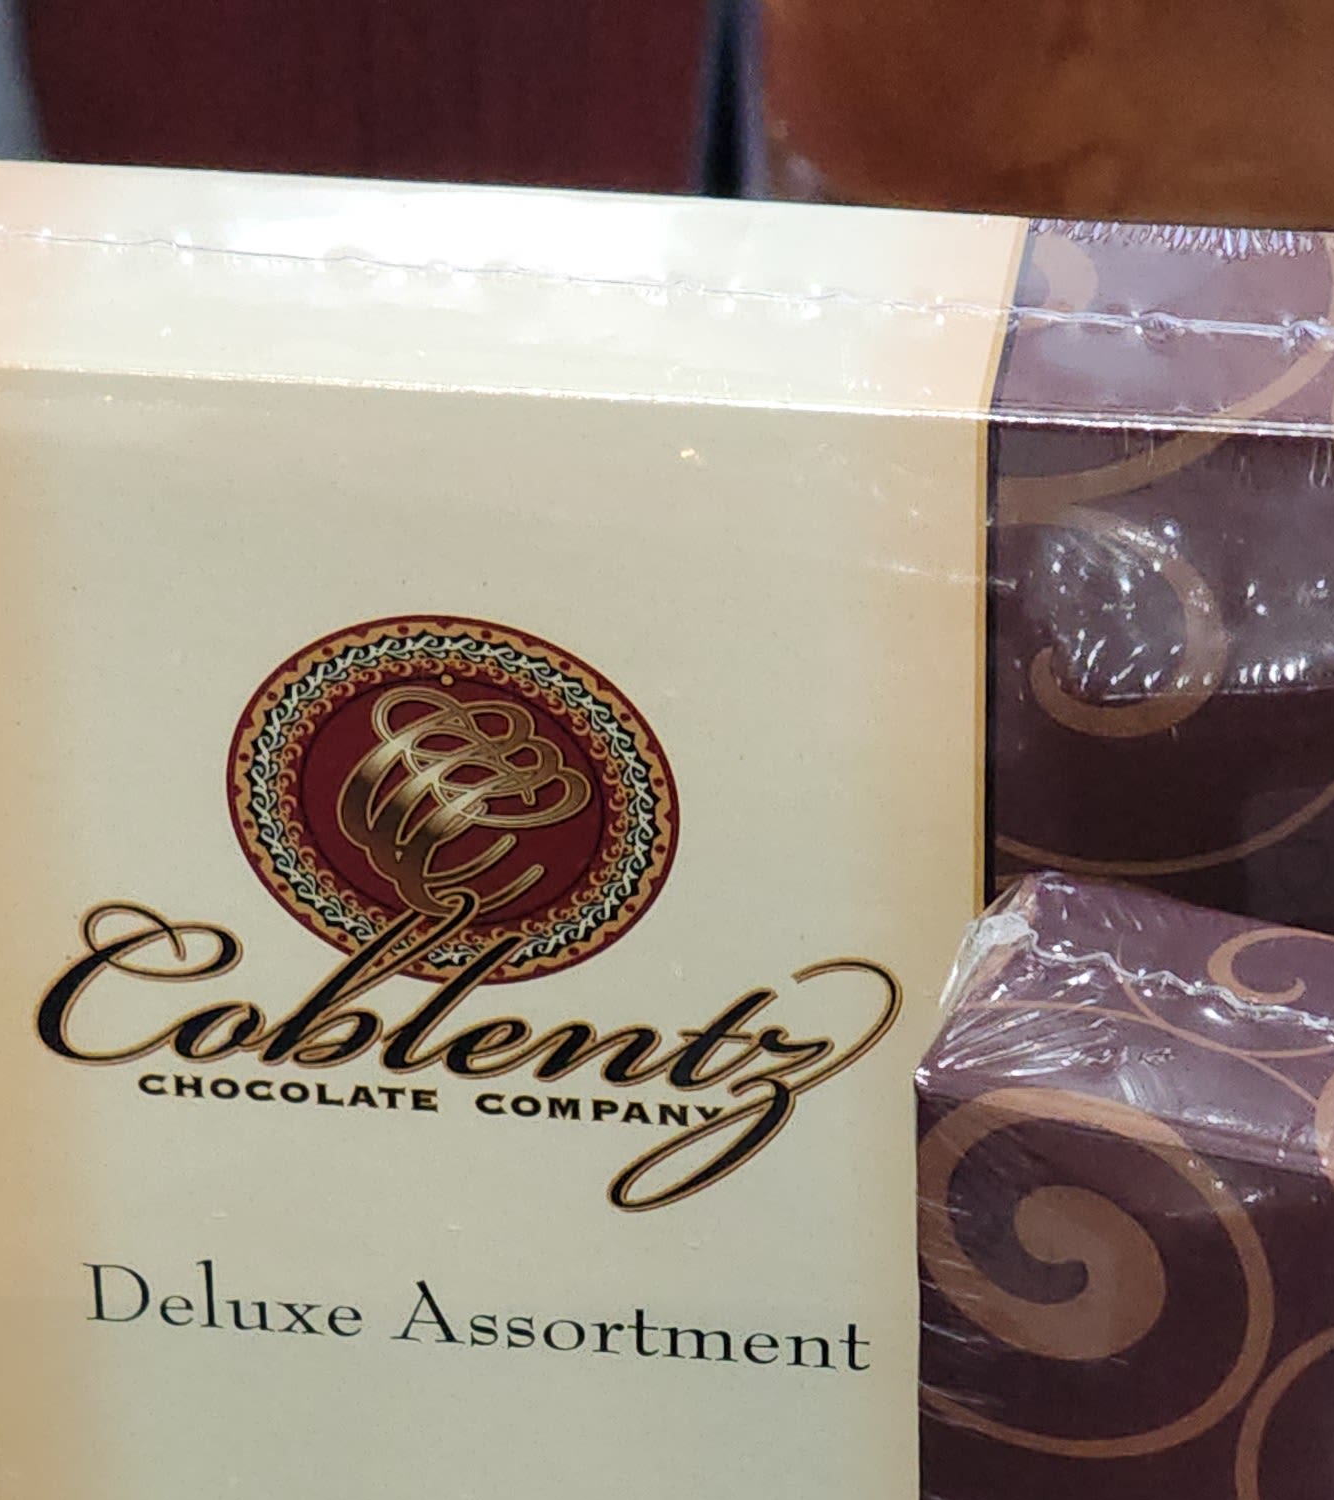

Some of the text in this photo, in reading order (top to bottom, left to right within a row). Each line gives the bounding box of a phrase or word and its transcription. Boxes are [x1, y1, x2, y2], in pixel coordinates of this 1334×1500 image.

[35, 888, 903, 1213] Coblentz
[137, 1073, 727, 1129] CHOCOLATE COMPANY
[82, 1259, 872, 1372] Deluxe Assortment
